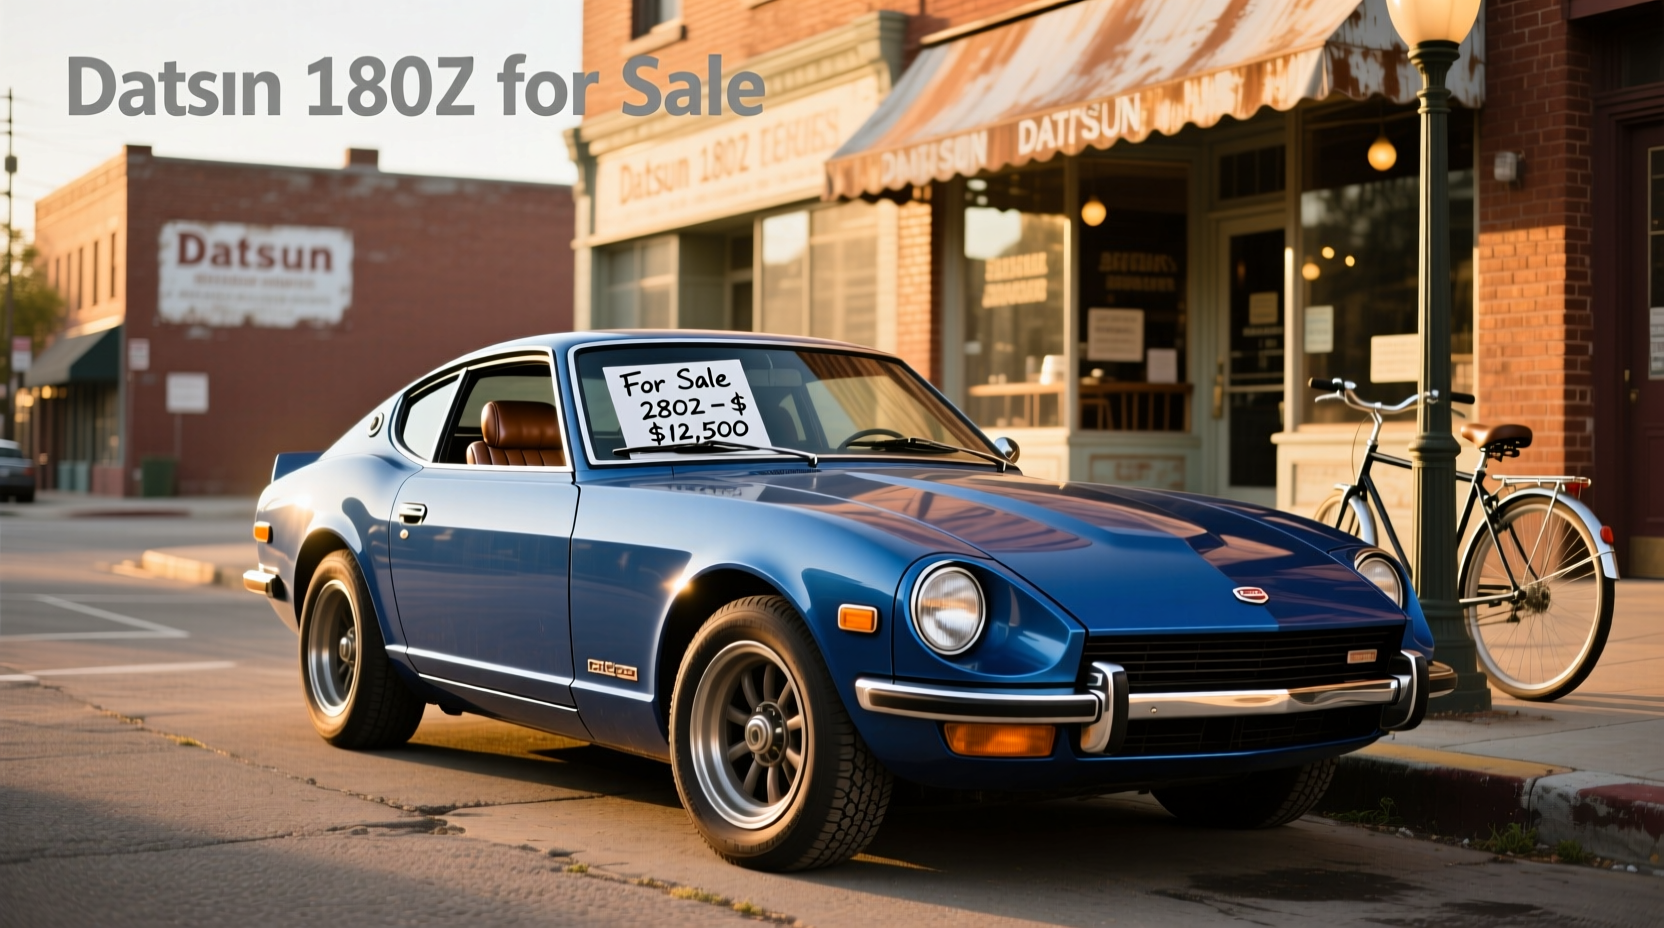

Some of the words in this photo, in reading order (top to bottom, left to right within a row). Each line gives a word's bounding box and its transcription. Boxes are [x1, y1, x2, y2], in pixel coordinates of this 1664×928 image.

[619, 157, 690, 205] Datsun
[178, 232, 333, 272] Datsun
[619, 370, 666, 397] For
[676, 366, 732, 390] Sale
[648, 419, 749, 446] $12,500
